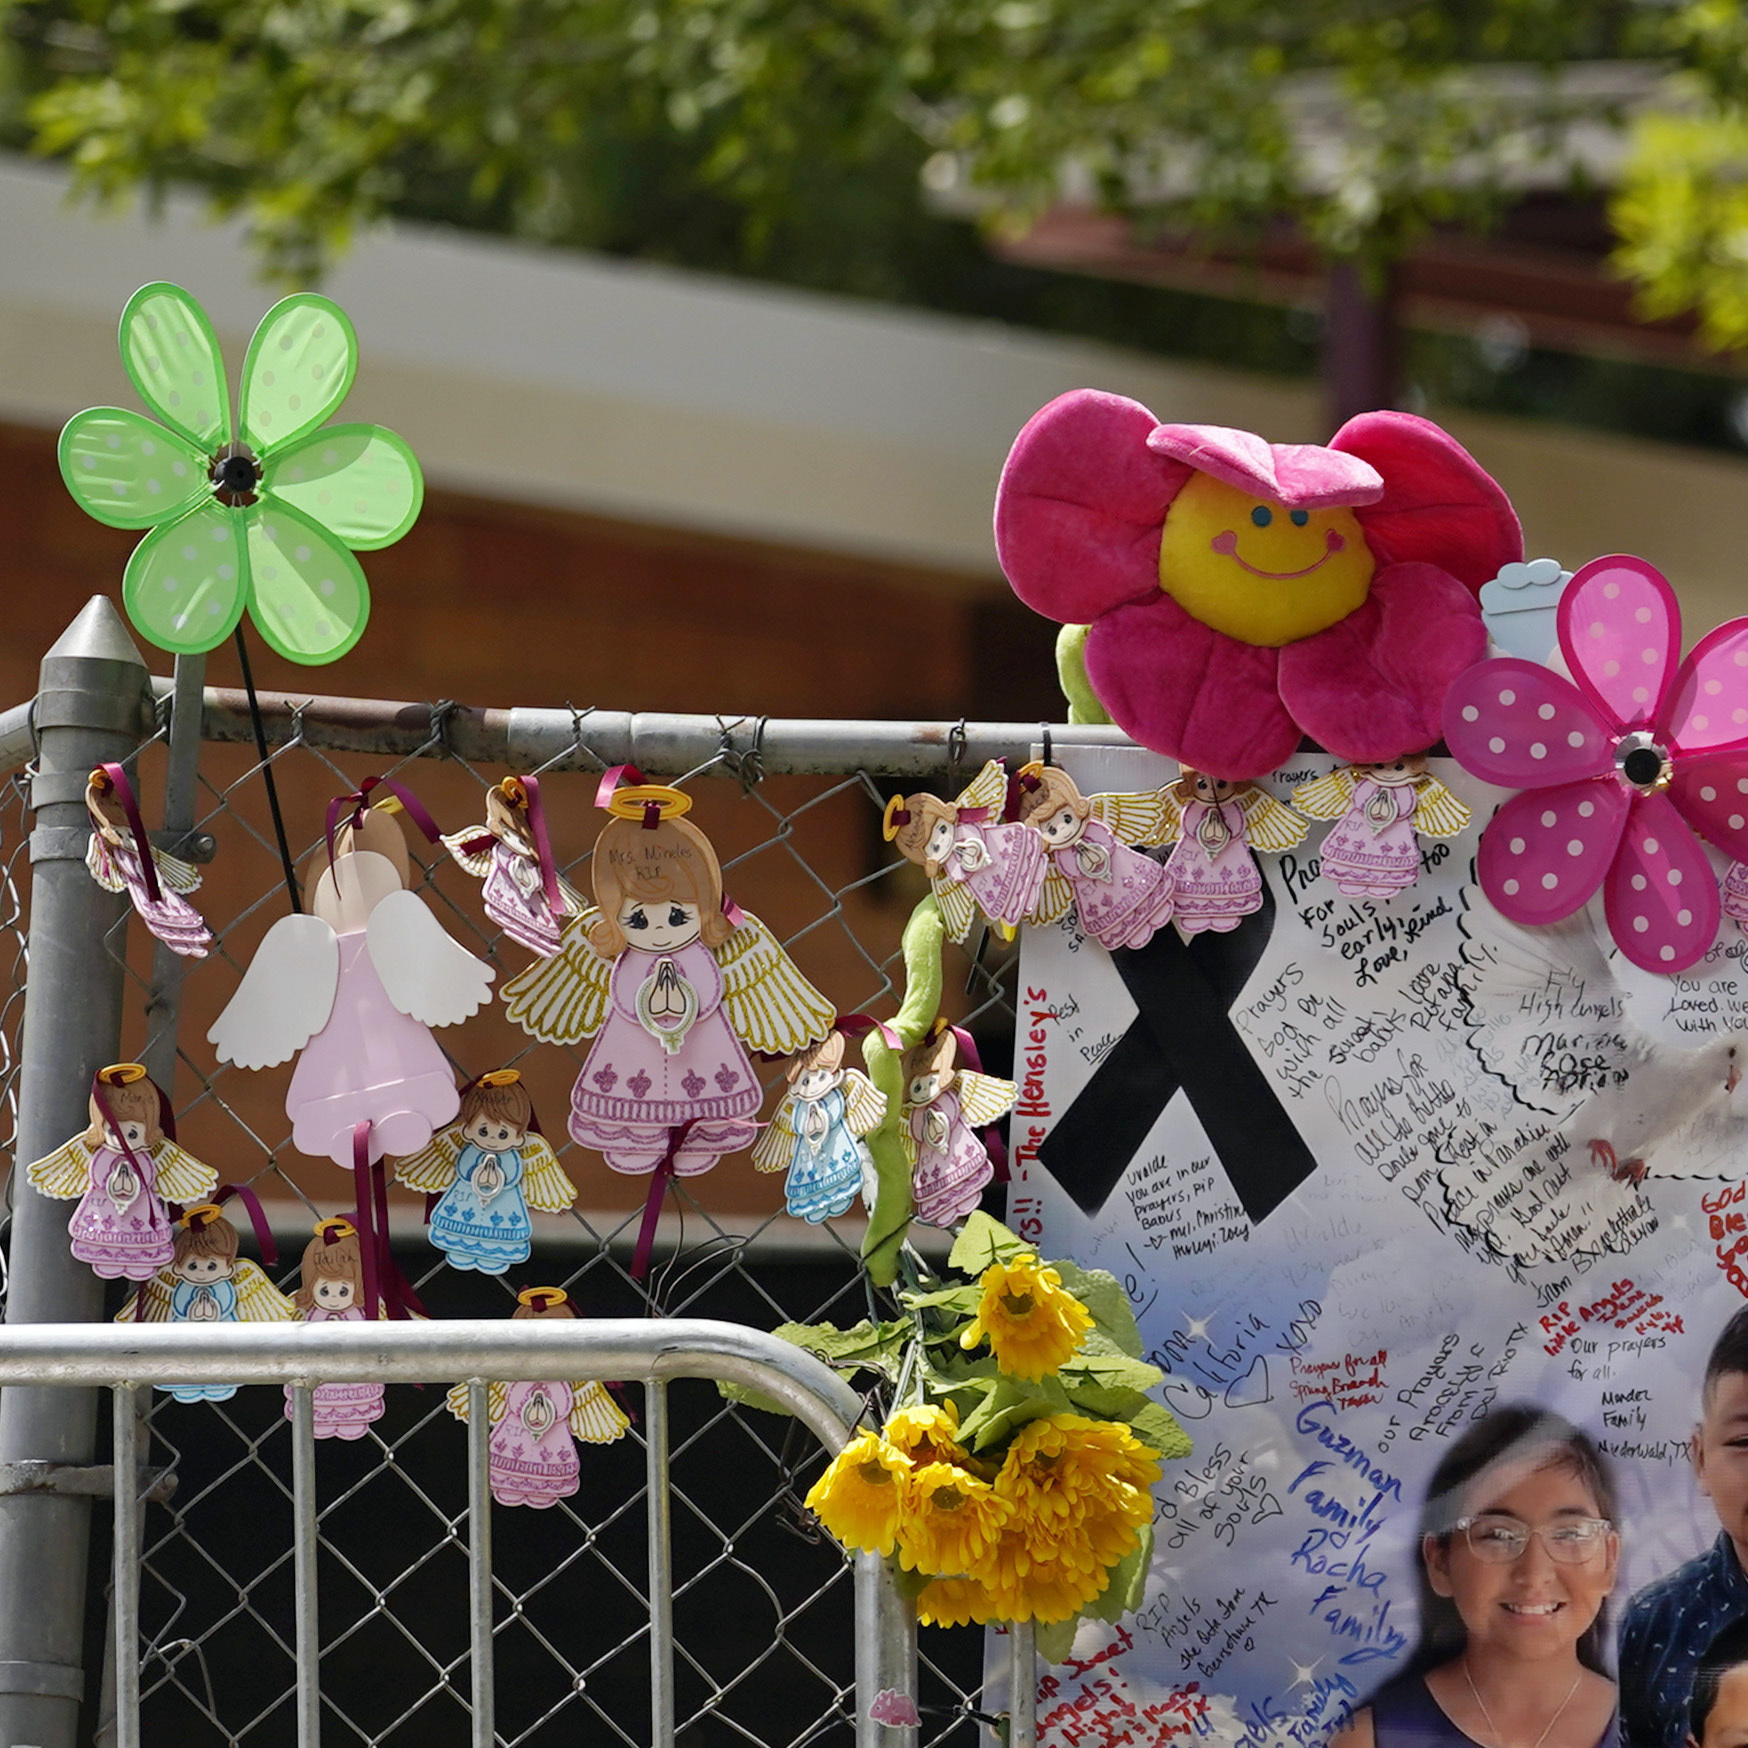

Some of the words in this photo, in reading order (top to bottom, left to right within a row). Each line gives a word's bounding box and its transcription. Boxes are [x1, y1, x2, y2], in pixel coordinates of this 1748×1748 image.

[1710, 976, 1739, 996] are
[1066, 1025, 1083, 1043] in
[1675, 1016, 1718, 1035] with
[1015, 985, 1048, 1119] Hensley's
[1607, 1335, 1666, 1360] prayers
[1566, 1362, 1591, 1382] for
[1602, 1408, 1647, 1431] Family
[1295, 1400, 1403, 1504] Guzman
[1174, 1442, 1234, 1497] Bless
[1199, 1492, 1221, 1521] of
[1287, 1457, 1388, 1547] Family
[1307, 1585, 1409, 1649] Family
